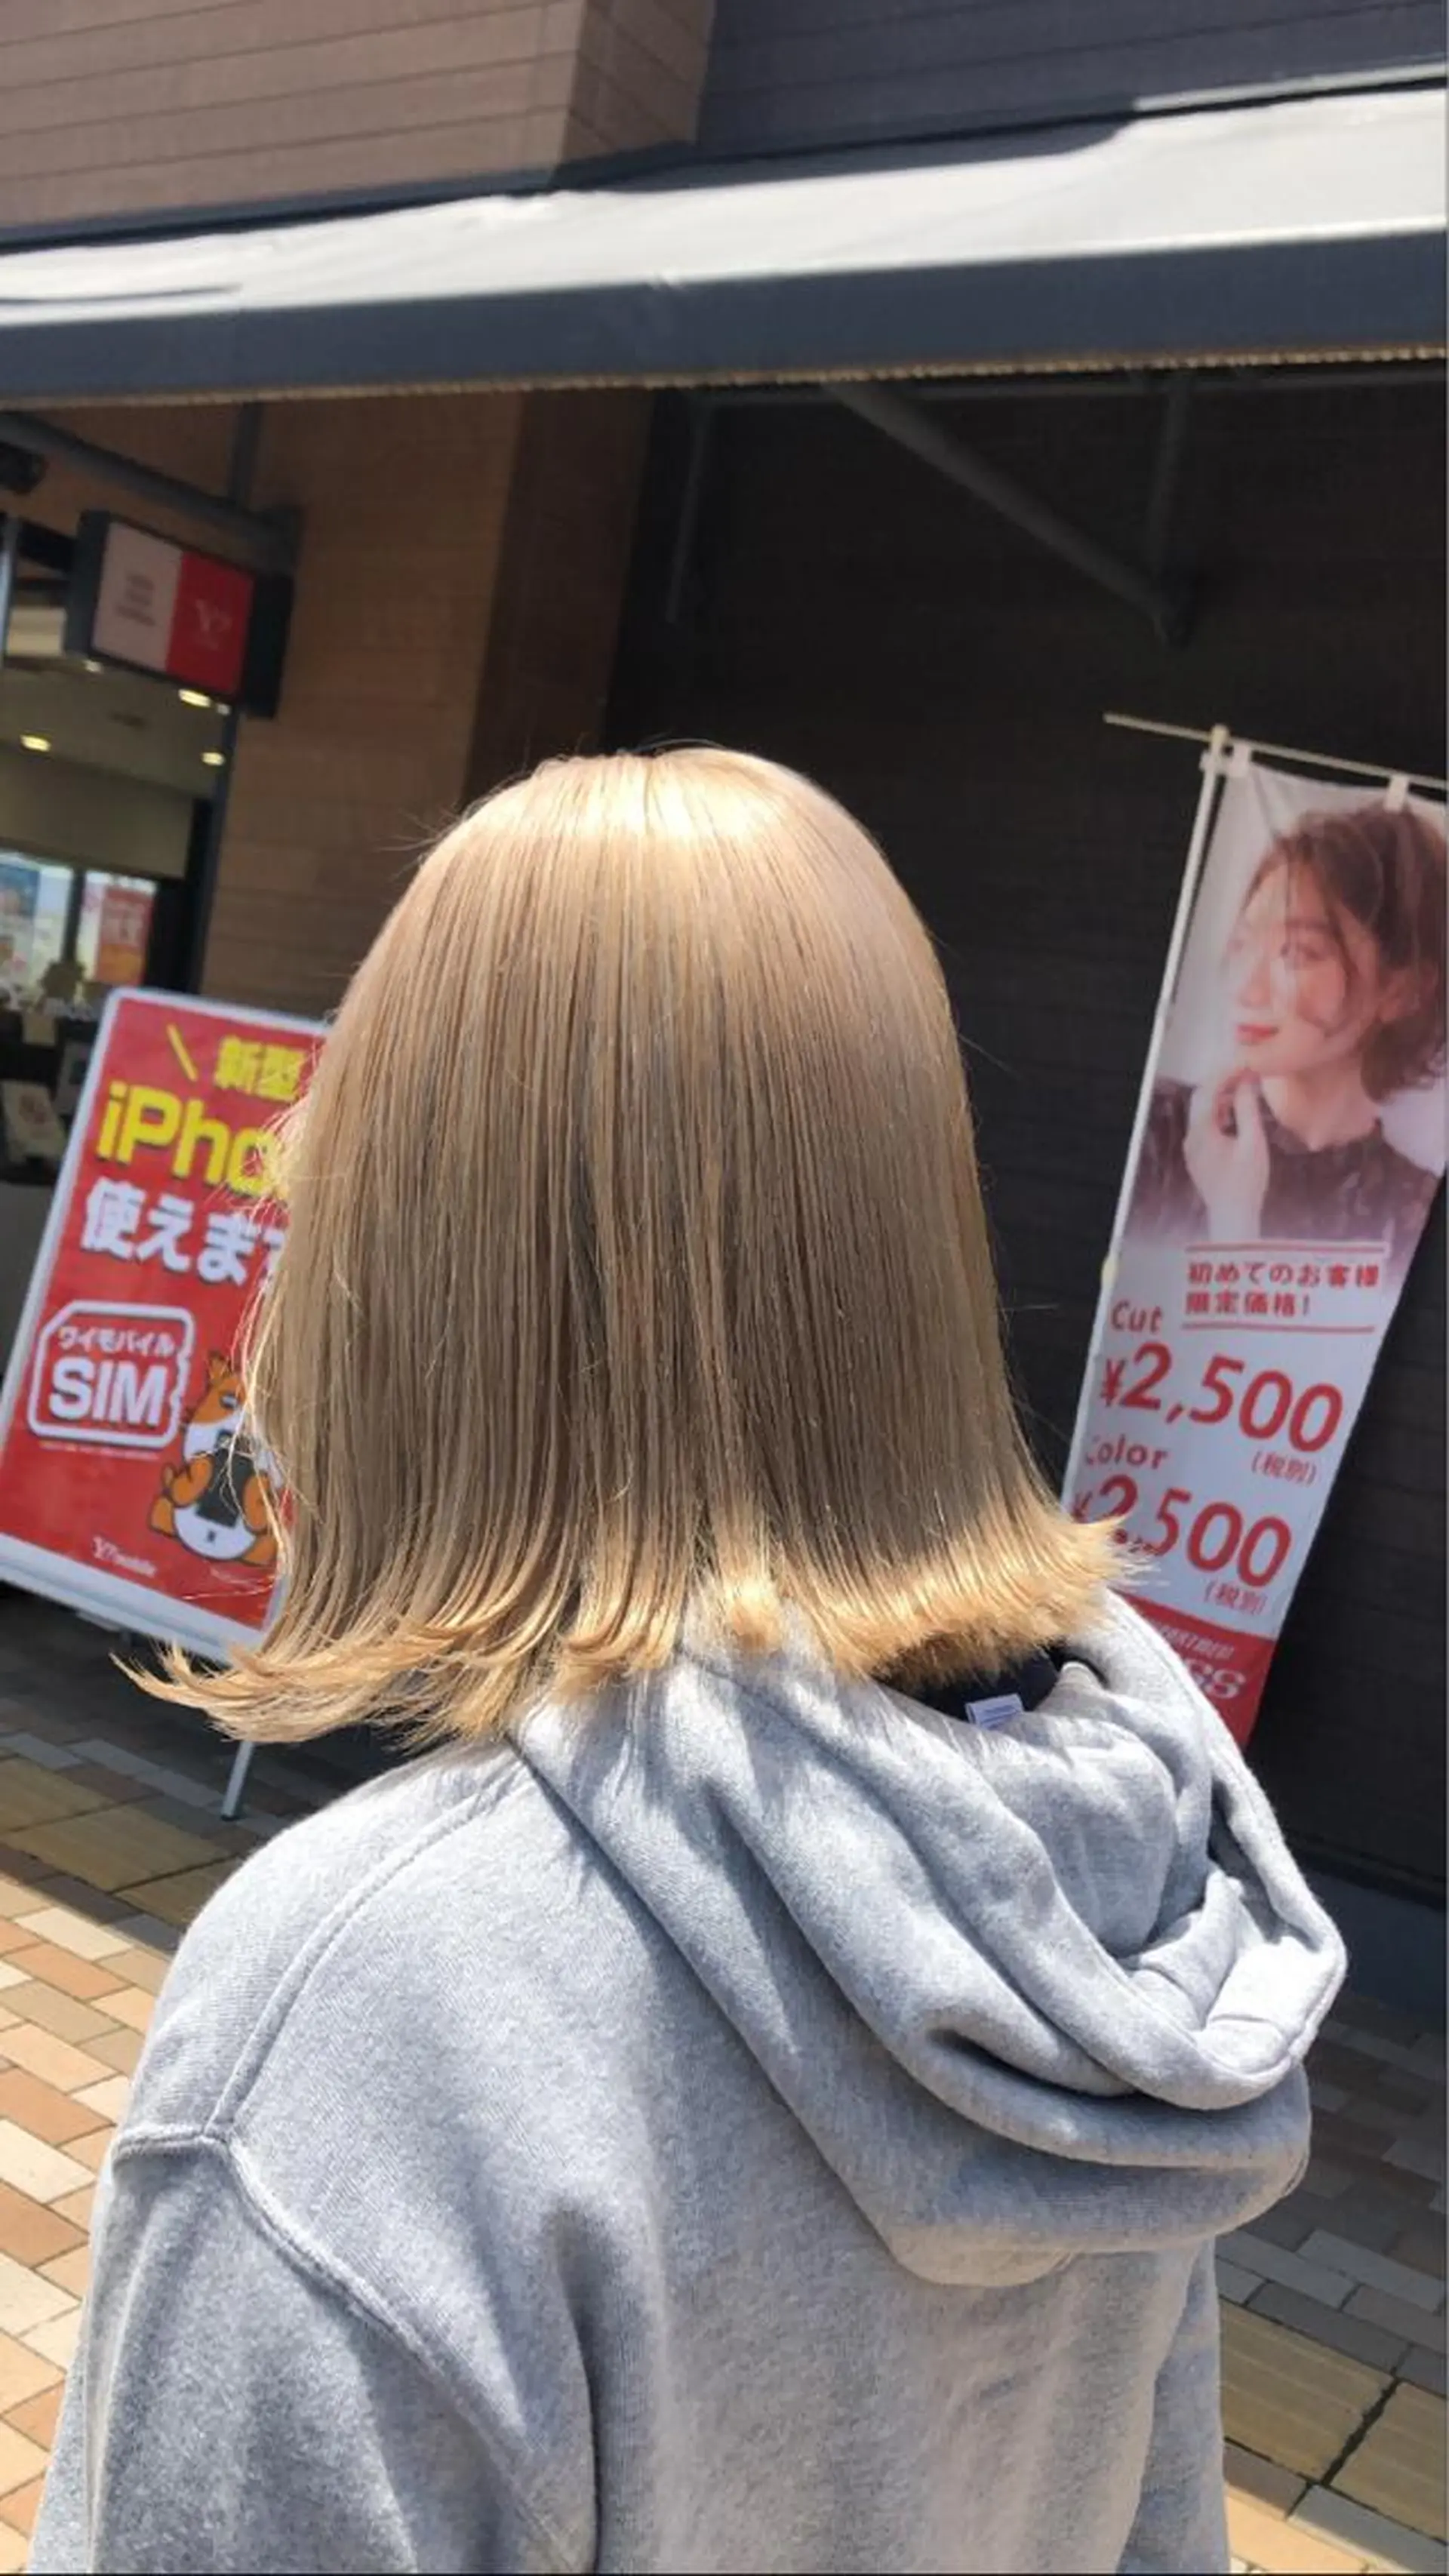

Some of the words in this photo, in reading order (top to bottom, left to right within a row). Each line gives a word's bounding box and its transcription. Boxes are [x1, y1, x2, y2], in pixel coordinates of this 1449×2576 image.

[1189, 1262, 1379, 1288] 初めてのお客様
[1110, 1300, 1163, 1333] Cut
[49, 1356, 168, 1426] SIM
[1100, 1341, 1343, 1453] ¥2,500
